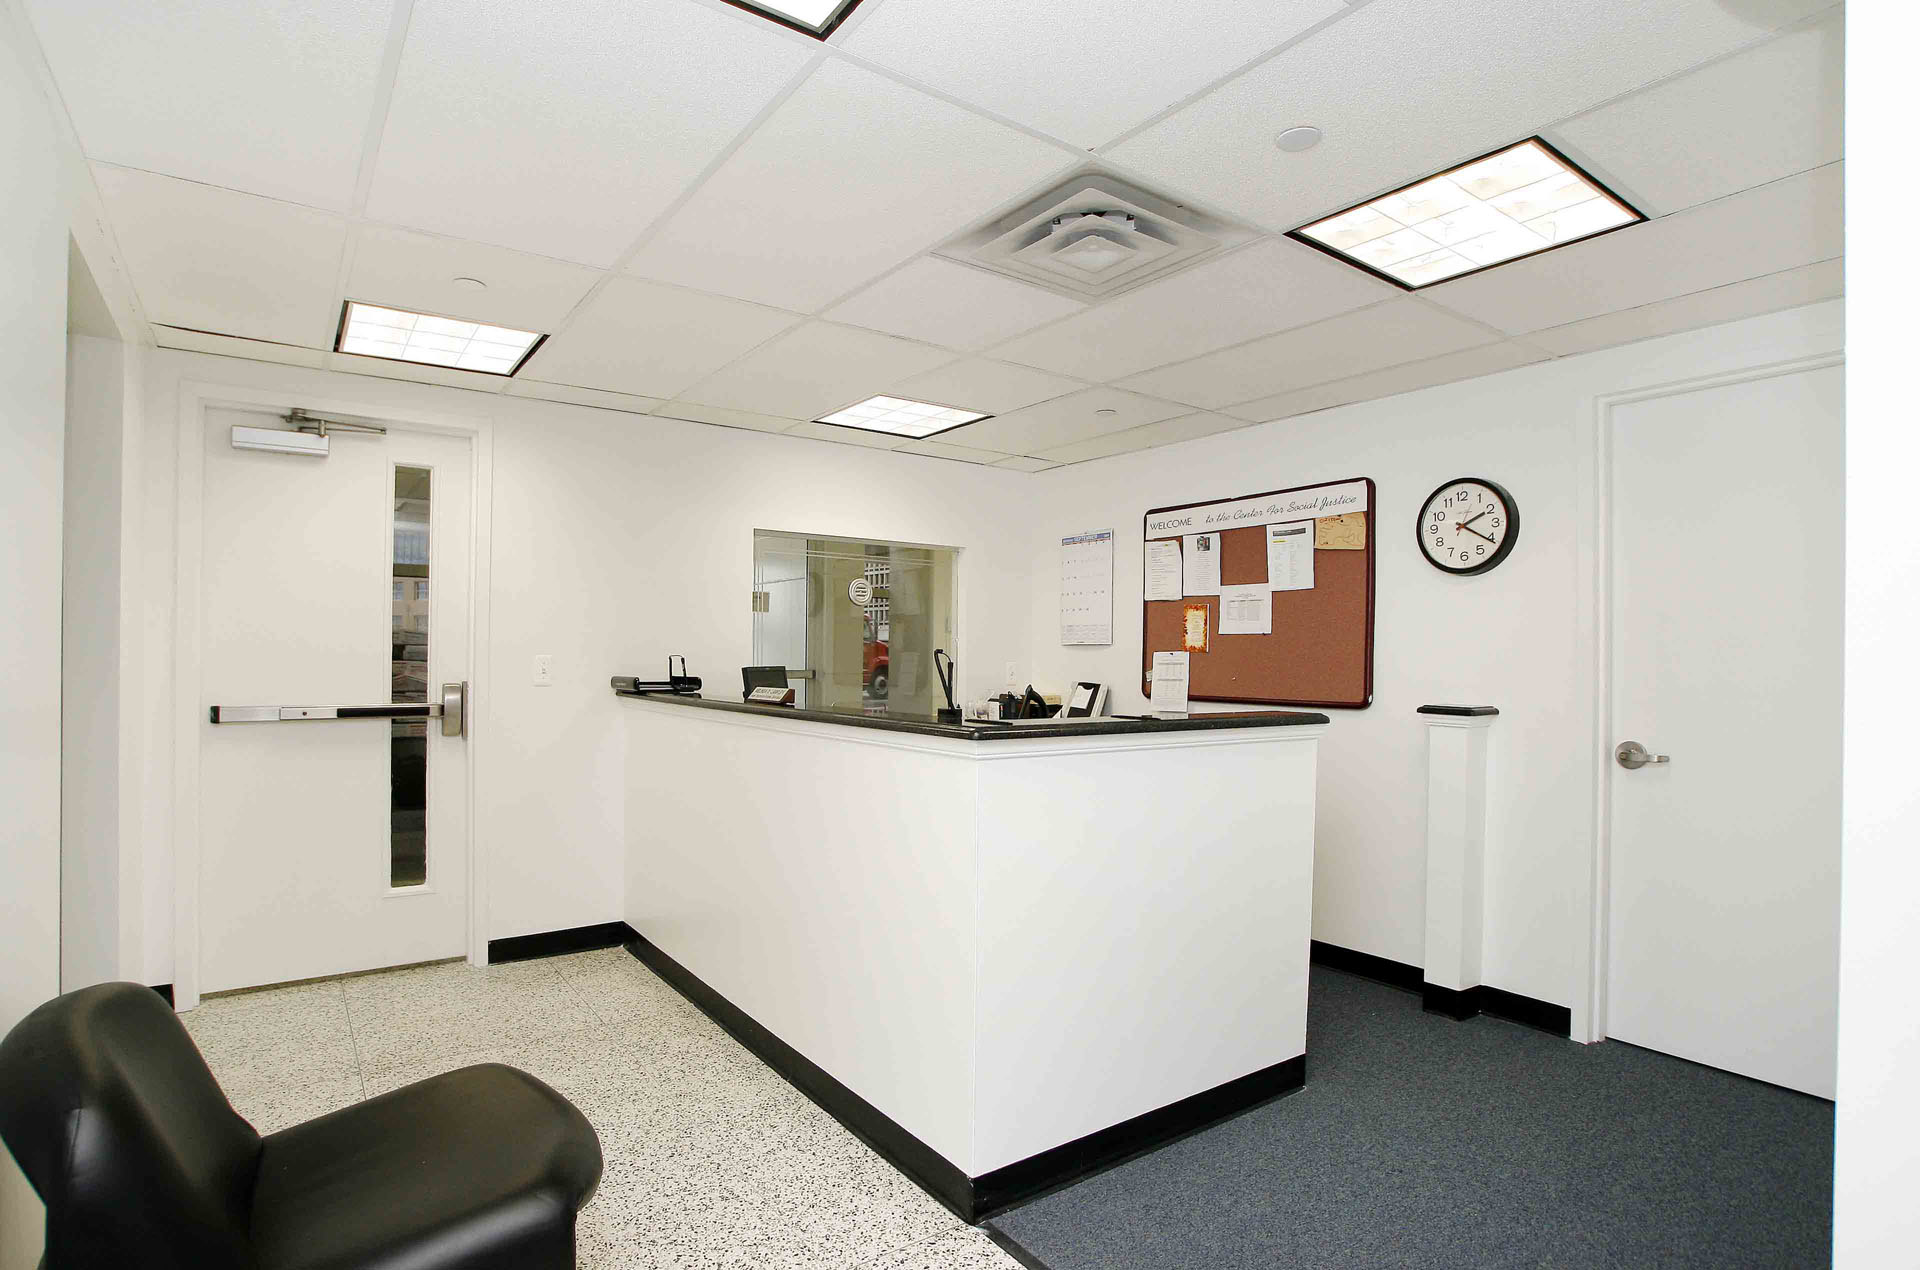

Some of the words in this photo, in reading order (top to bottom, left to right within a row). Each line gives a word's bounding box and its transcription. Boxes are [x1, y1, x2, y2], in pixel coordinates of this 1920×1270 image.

[1456, 491, 1468, 502] 12
[1444, 497, 1453, 508] 11
[1150, 518, 1192, 530] WELCOME
[1205, 515, 1214, 524] to
[1216, 512, 1230, 523] the
[1233, 508, 1263, 520] Center
[1267, 504, 1284, 515] For
[1287, 497, 1318, 512] Social
[1319, 494, 1357, 511] Justice
[1486, 503, 1495, 514] 2
[1433, 511, 1446, 522] 10
[1491, 517, 1500, 528] 3
[1430, 524, 1439, 534] 9
[1435, 537, 1444, 547] 8
[1487, 532, 1495, 543] 4
[1447, 547, 1455, 557] 7
[1476, 544, 1485, 555] 5
[1460, 551, 1469, 561] 6
